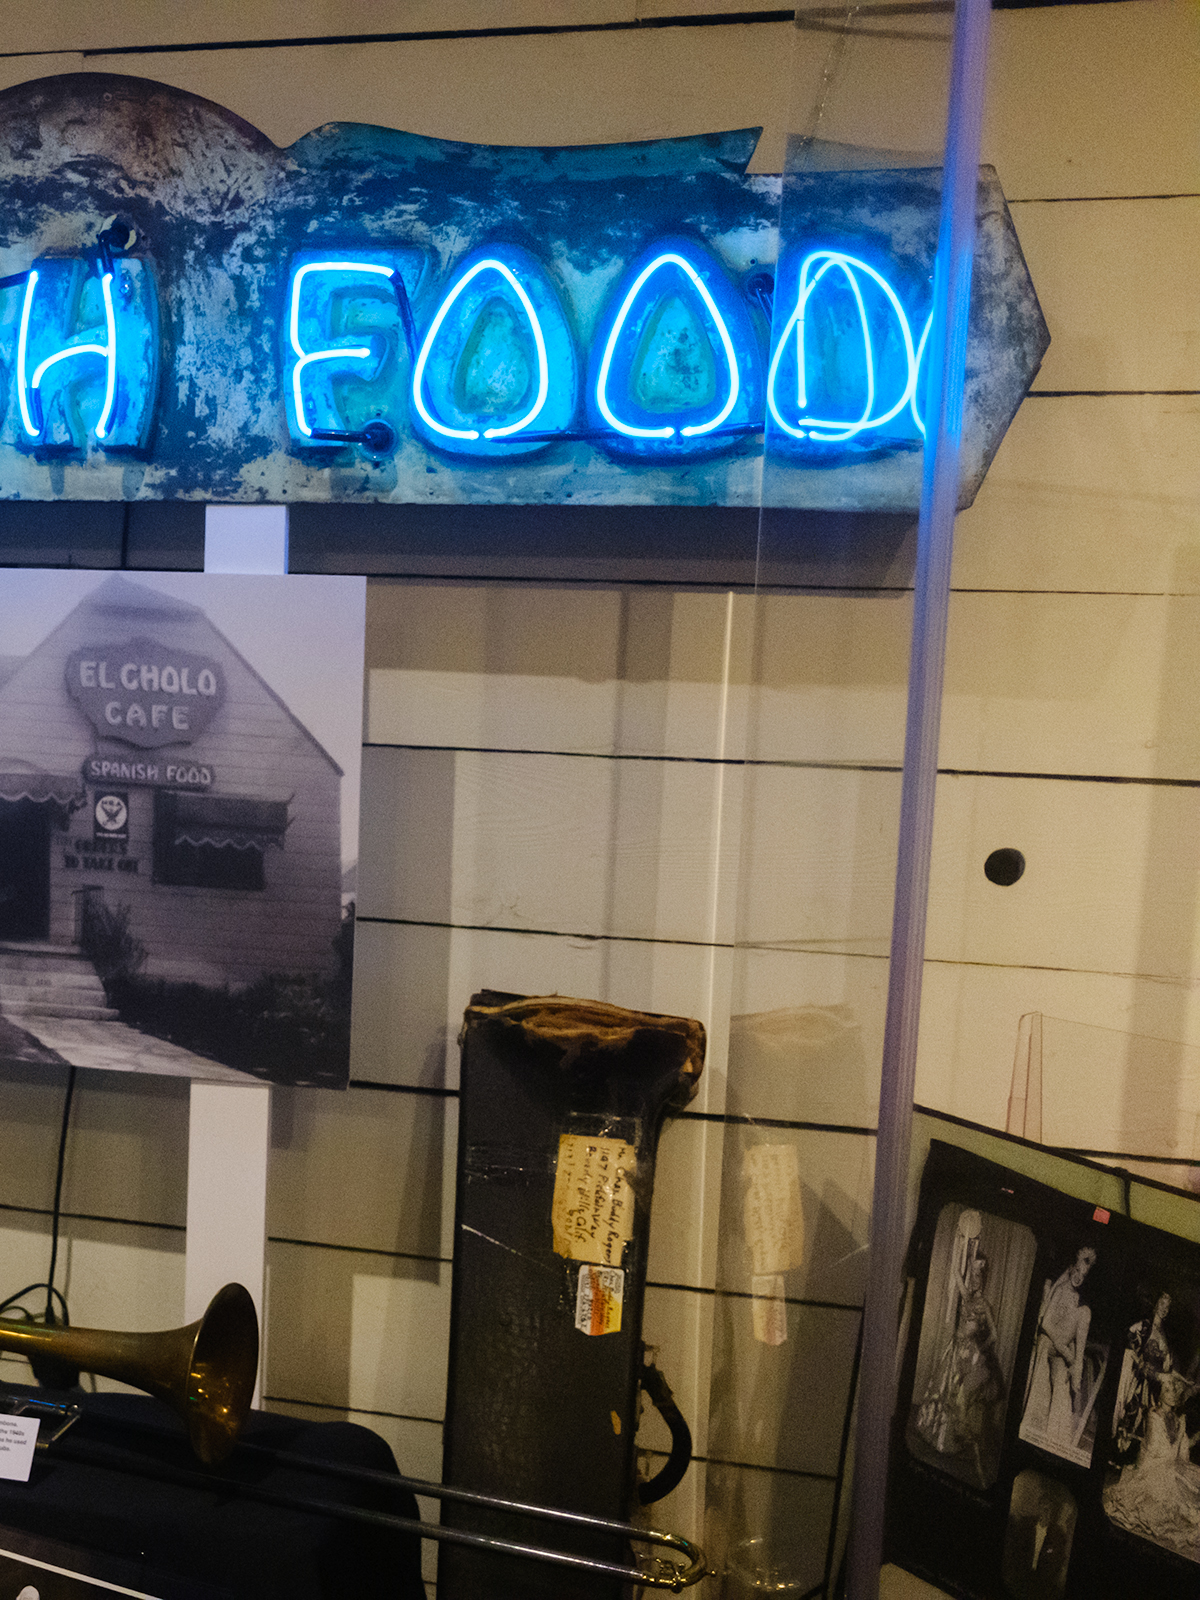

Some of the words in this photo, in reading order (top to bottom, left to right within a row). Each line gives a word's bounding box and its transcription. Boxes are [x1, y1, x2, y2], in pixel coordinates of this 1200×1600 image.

[289, 249, 918, 440] FOOD
[80, 660, 116, 690] EL
[120, 662, 217, 696] CHOLO
[104, 701, 190, 731] CAFE
[90, 760, 159, 781] SPANISH
[166, 765, 211, 785] FOOD
